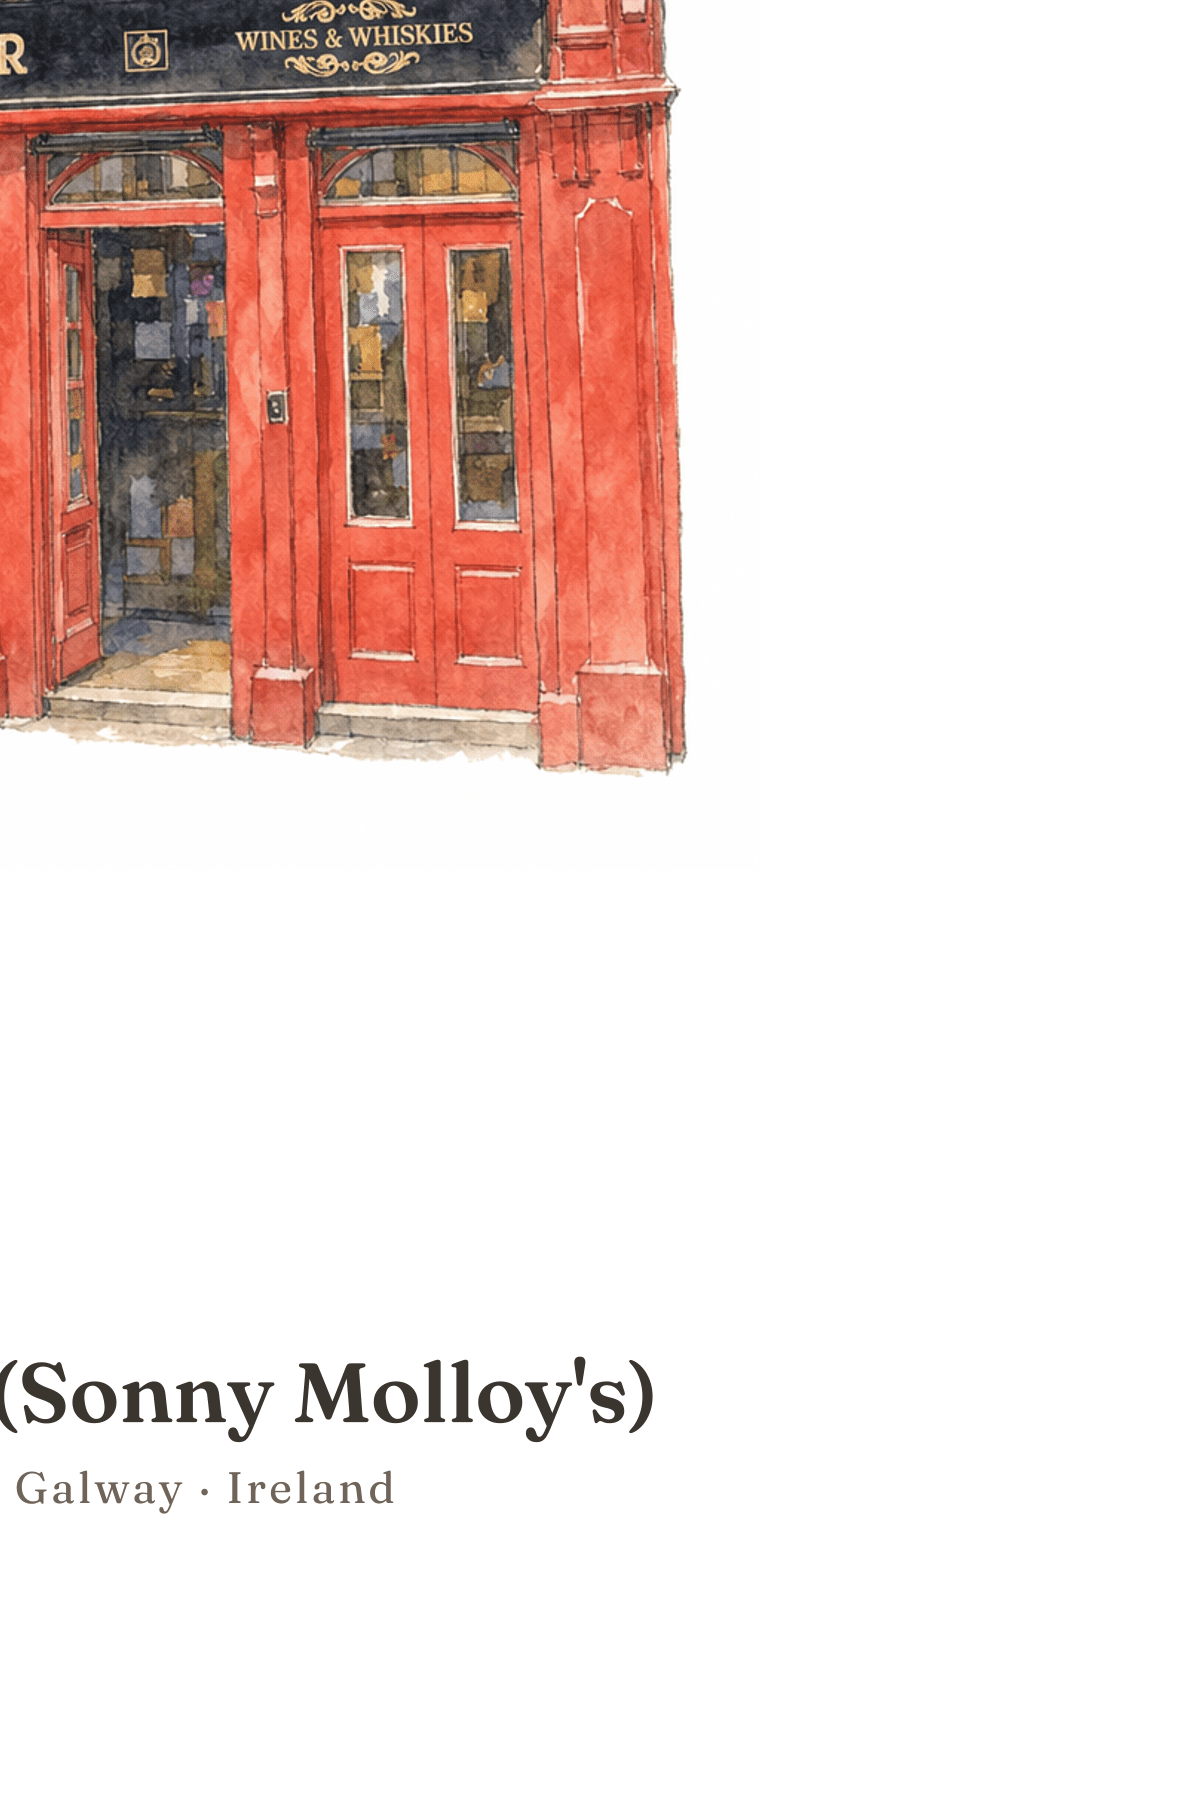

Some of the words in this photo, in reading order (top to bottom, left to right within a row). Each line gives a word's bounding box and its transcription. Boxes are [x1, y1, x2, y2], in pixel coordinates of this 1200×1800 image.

[235, 28, 319, 51] WINES
[325, 27, 343, 49] &
[348, 22, 474, 48] WHISKIES
